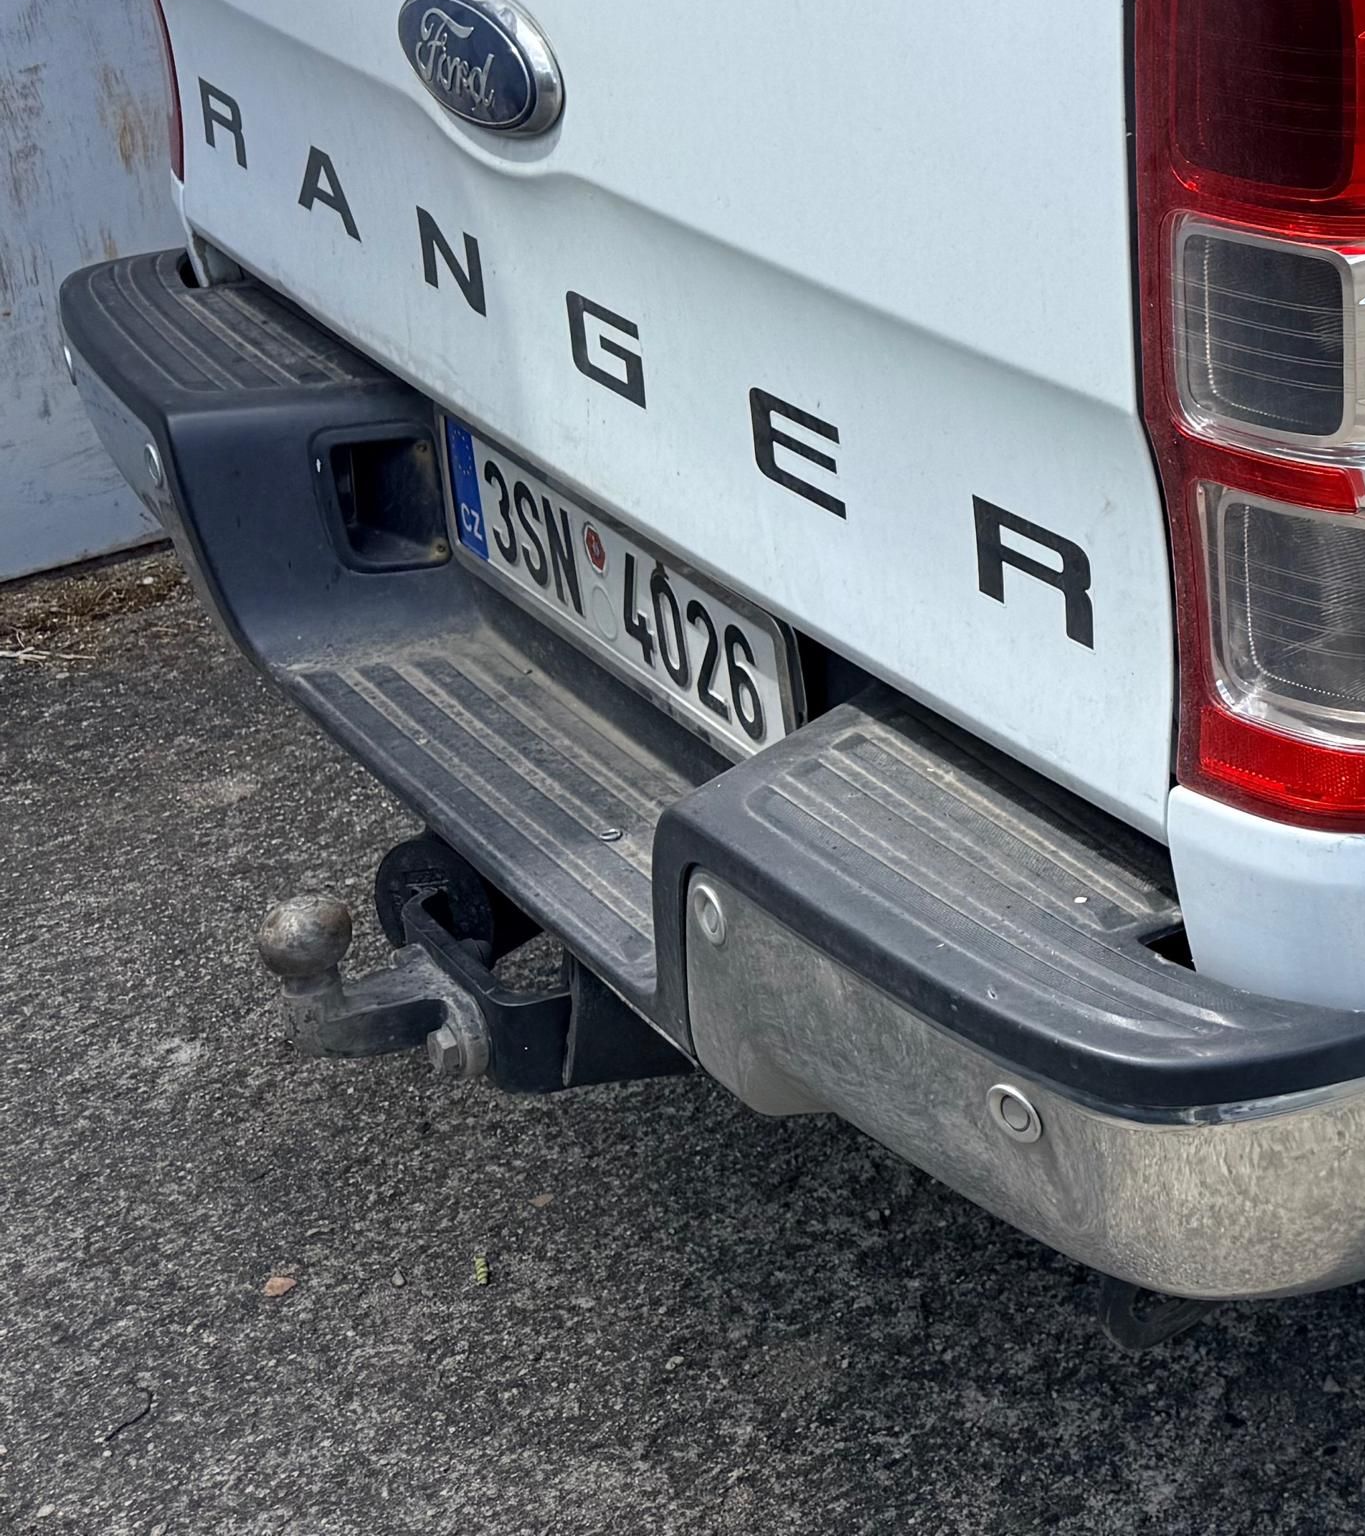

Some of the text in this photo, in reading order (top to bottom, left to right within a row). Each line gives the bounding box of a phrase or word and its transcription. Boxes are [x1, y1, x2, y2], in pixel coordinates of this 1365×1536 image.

[415, 7, 495, 111] Ford
[198, 77, 1095, 651] RANGER
[461, 502, 483, 541] CZ
[484, 460, 767, 741] 3SN 4026
